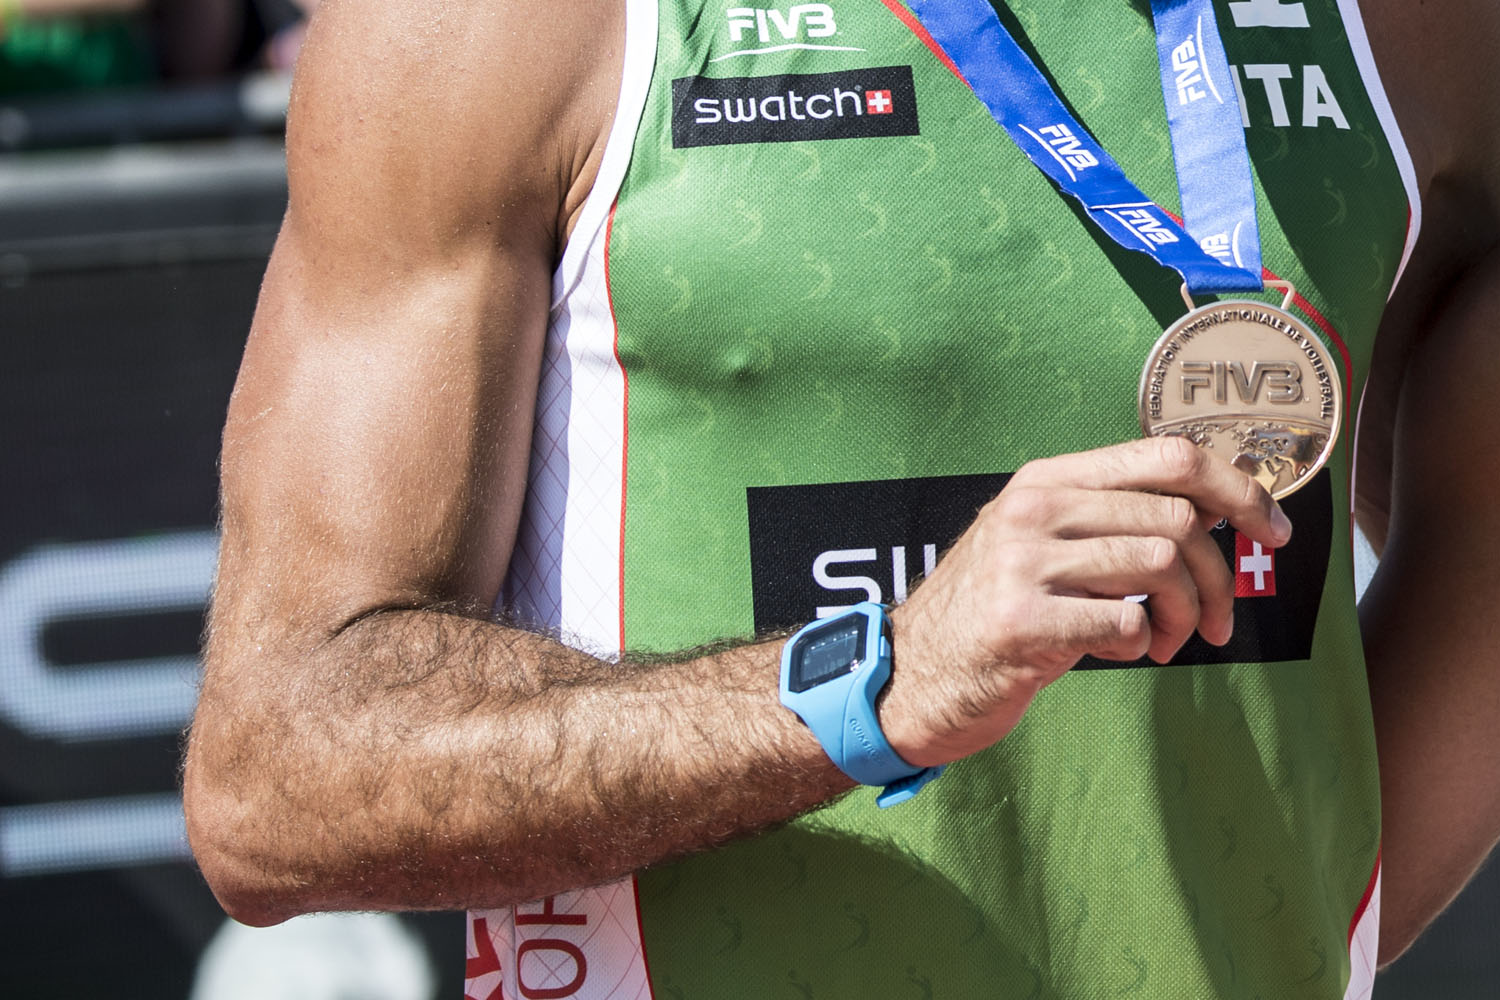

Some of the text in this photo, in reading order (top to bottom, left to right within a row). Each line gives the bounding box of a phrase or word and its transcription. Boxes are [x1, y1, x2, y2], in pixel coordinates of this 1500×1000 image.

[727, 3, 837, 42] FIVB
[1171, 39, 1206, 105] FIVB
[694, 87, 863, 124] swatch
[1039, 123, 1099, 168] FIVB
[1119, 209, 1179, 244] FIVB
[1150, 309, 1335, 419] FEDERATION INTERNATIONALE DE VOLLEYBALL
[1180, 360, 1304, 406] FIVB
